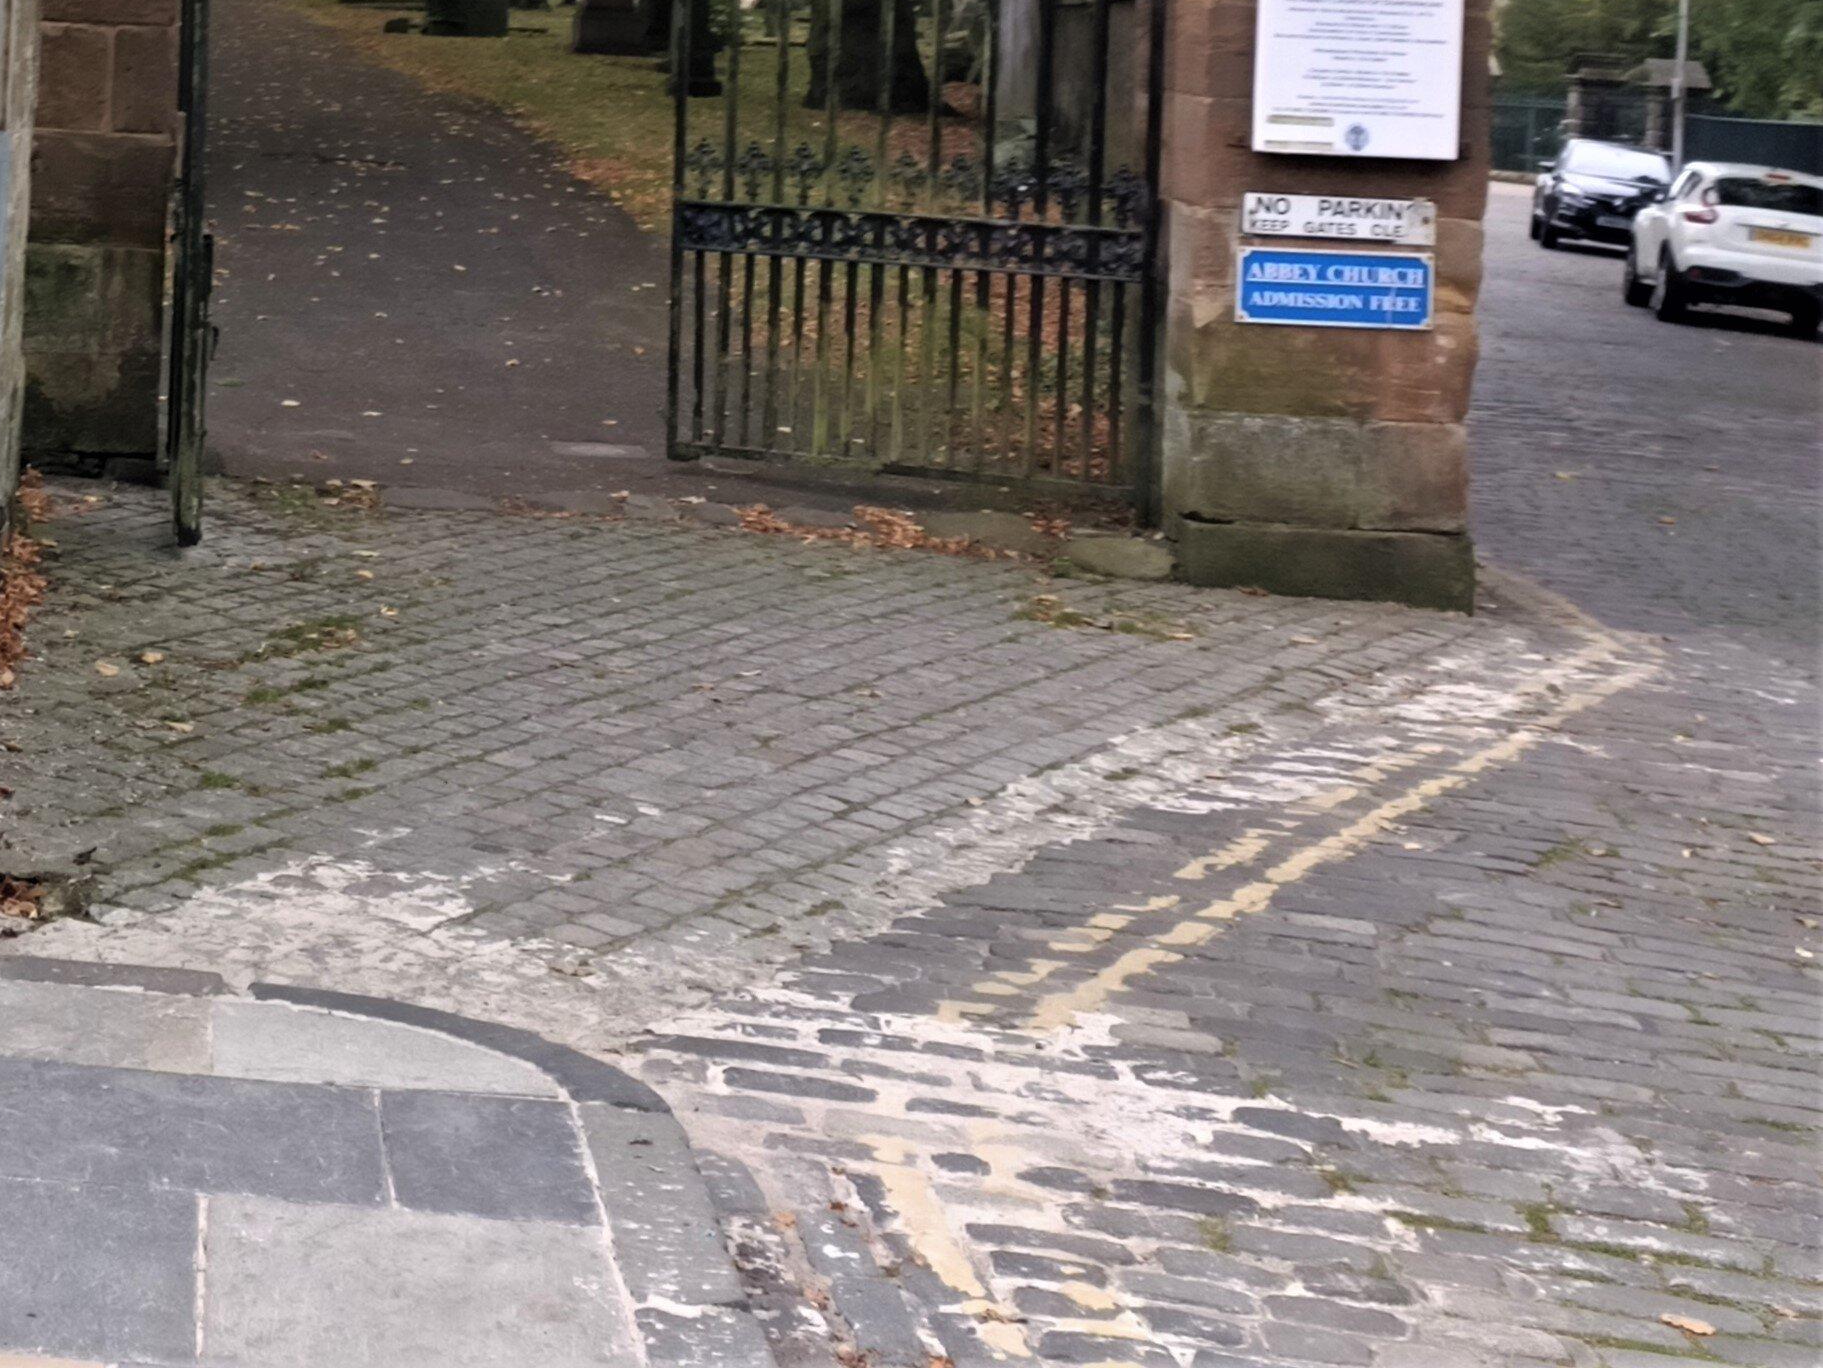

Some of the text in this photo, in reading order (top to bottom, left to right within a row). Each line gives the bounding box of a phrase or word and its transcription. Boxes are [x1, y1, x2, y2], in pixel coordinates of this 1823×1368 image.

[1250, 196, 1412, 220] NO PARKIN
[1249, 218, 1406, 239] KEEP GATES CLE
[1246, 262, 1425, 286] ABBEY CHURCH
[1248, 291, 1422, 313] ADMISSION FREE
